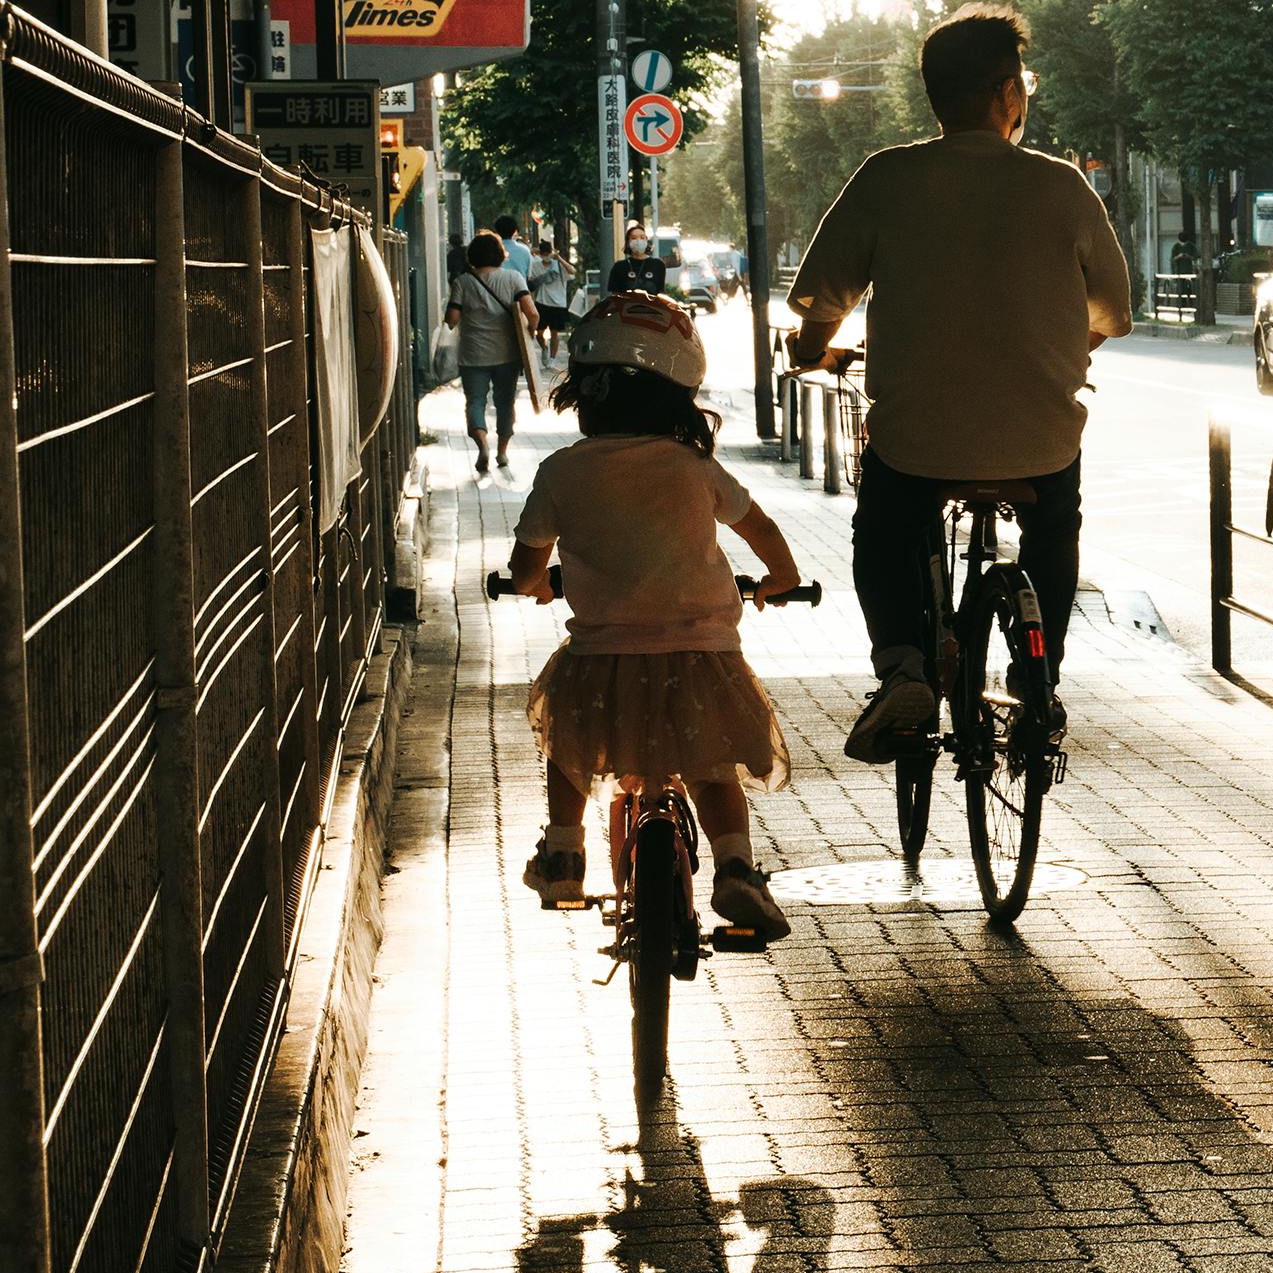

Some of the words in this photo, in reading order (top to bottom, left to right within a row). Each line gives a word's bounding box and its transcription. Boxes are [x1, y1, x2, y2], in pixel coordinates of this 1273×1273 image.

[345, 0, 437, 29] Times
[256, 97, 369, 125] 一時利用
[264, 142, 365, 174] 自転車
